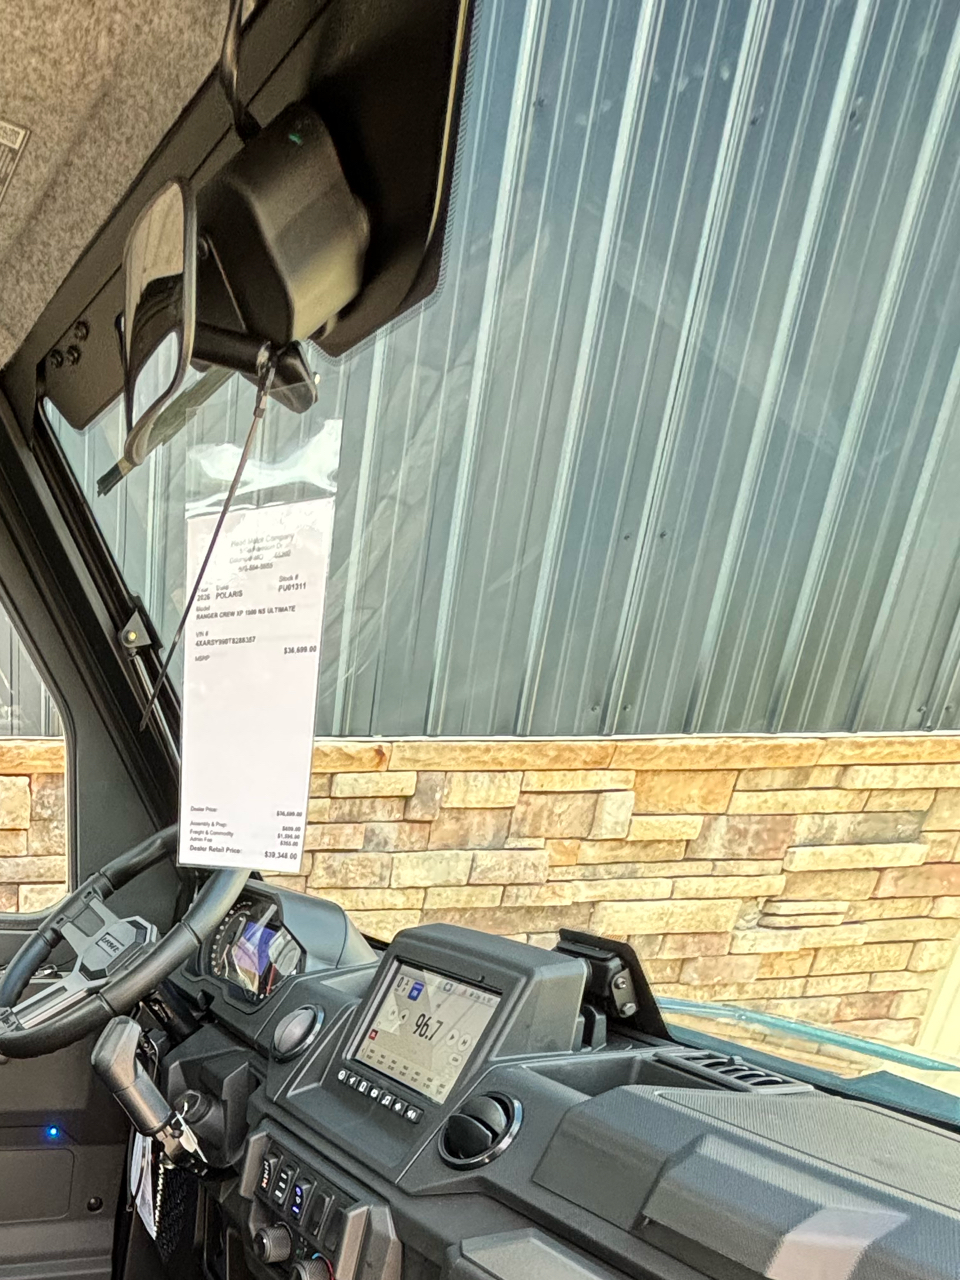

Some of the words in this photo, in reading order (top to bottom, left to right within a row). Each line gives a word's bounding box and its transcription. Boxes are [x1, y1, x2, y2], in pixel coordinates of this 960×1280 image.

[265, 534, 295, 543] Company
[278, 582, 307, 592] PU01311
[215, 590, 243, 600] POLARIS
[196, 612, 218, 620] RANGER
[267, 605, 296, 614] ULTIMATE
[283, 645, 317, 655] $36,699.00
[190, 820, 210, 828] Assembly
[210, 830, 234, 838] Commodity
[190, 844, 207, 852] Dealer
[208, 845, 224, 853] Retail
[264, 850, 298, 860] $39,348.00
[413, 1013, 444, 1041] 96.7
